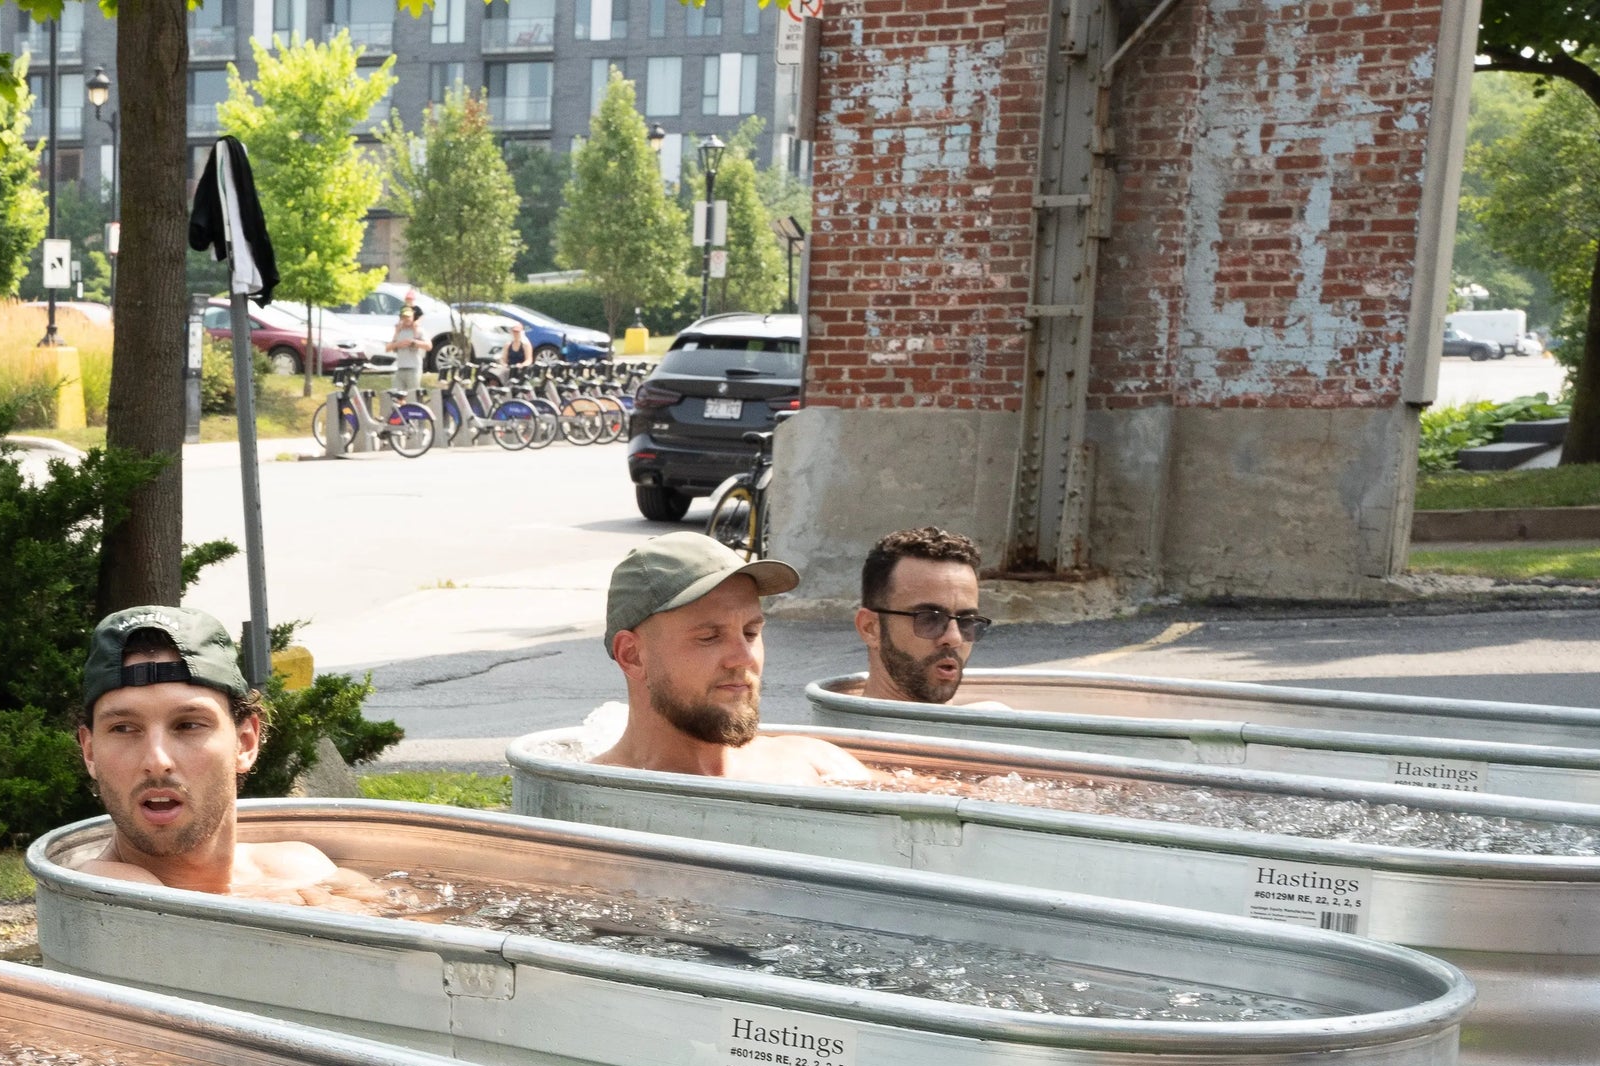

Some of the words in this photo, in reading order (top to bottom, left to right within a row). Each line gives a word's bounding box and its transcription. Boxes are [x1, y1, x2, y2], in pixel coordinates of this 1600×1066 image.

[1395, 761, 1479, 783] Hastings
[1256, 867, 1359, 895] Hastings
[1254, 890, 1295, 901] #60129M
[1297, 894, 1313, 904] RE,
[1315, 896, 1330, 905] 22,
[1332, 897, 1341, 907] 2,
[1343, 898, 1353, 908] 2,
[731, 1017, 844, 1058] Hastings
[730, 1047, 773, 1062] #60129S
[775, 1054, 792, 1066] RE,
